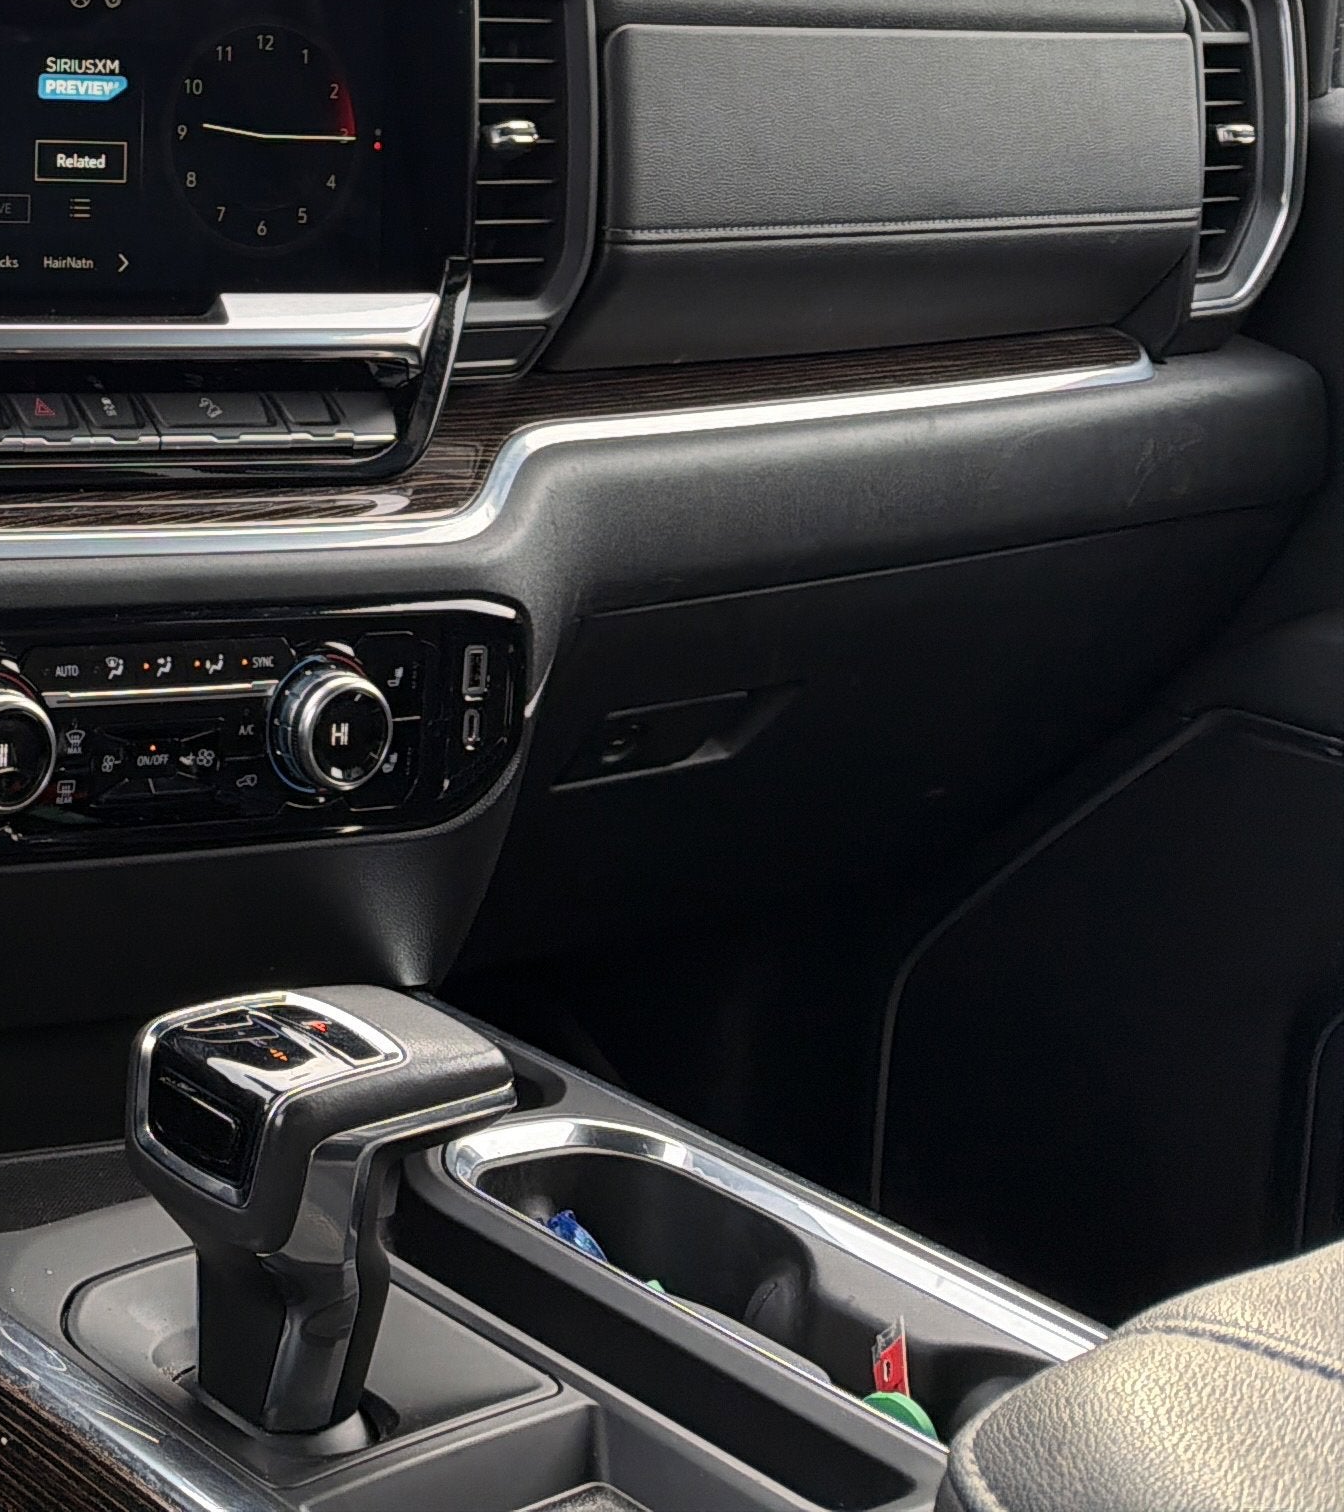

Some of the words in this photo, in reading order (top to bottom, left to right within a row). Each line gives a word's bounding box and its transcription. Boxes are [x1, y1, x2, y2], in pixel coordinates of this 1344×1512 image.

[256, 35, 275, 51] 12
[215, 46, 233, 62] 11
[301, 48, 310, 64] 1
[46, 56, 120, 74] SIRIUSXM
[45, 79, 119, 96] PREVIEW
[183, 79, 203, 96] 10
[329, 84, 339, 99] 2
[176, 125, 187, 140] 9
[56, 153, 106, 169] Related
[185, 171, 197, 188] 8
[326, 174, 337, 189] 4
[216, 207, 226, 222] 7
[298, 207, 308, 224] 5
[256, 221, 268, 236] 6
[43, 257, 94, 270] HairNatn
[251, 657, 274, 669] SYNC
[55, 665, 79, 678] AUTO
[238, 724, 255, 735] A/C
[330, 723, 350, 746] HI
[137, 753, 169, 766] ON/OFF
